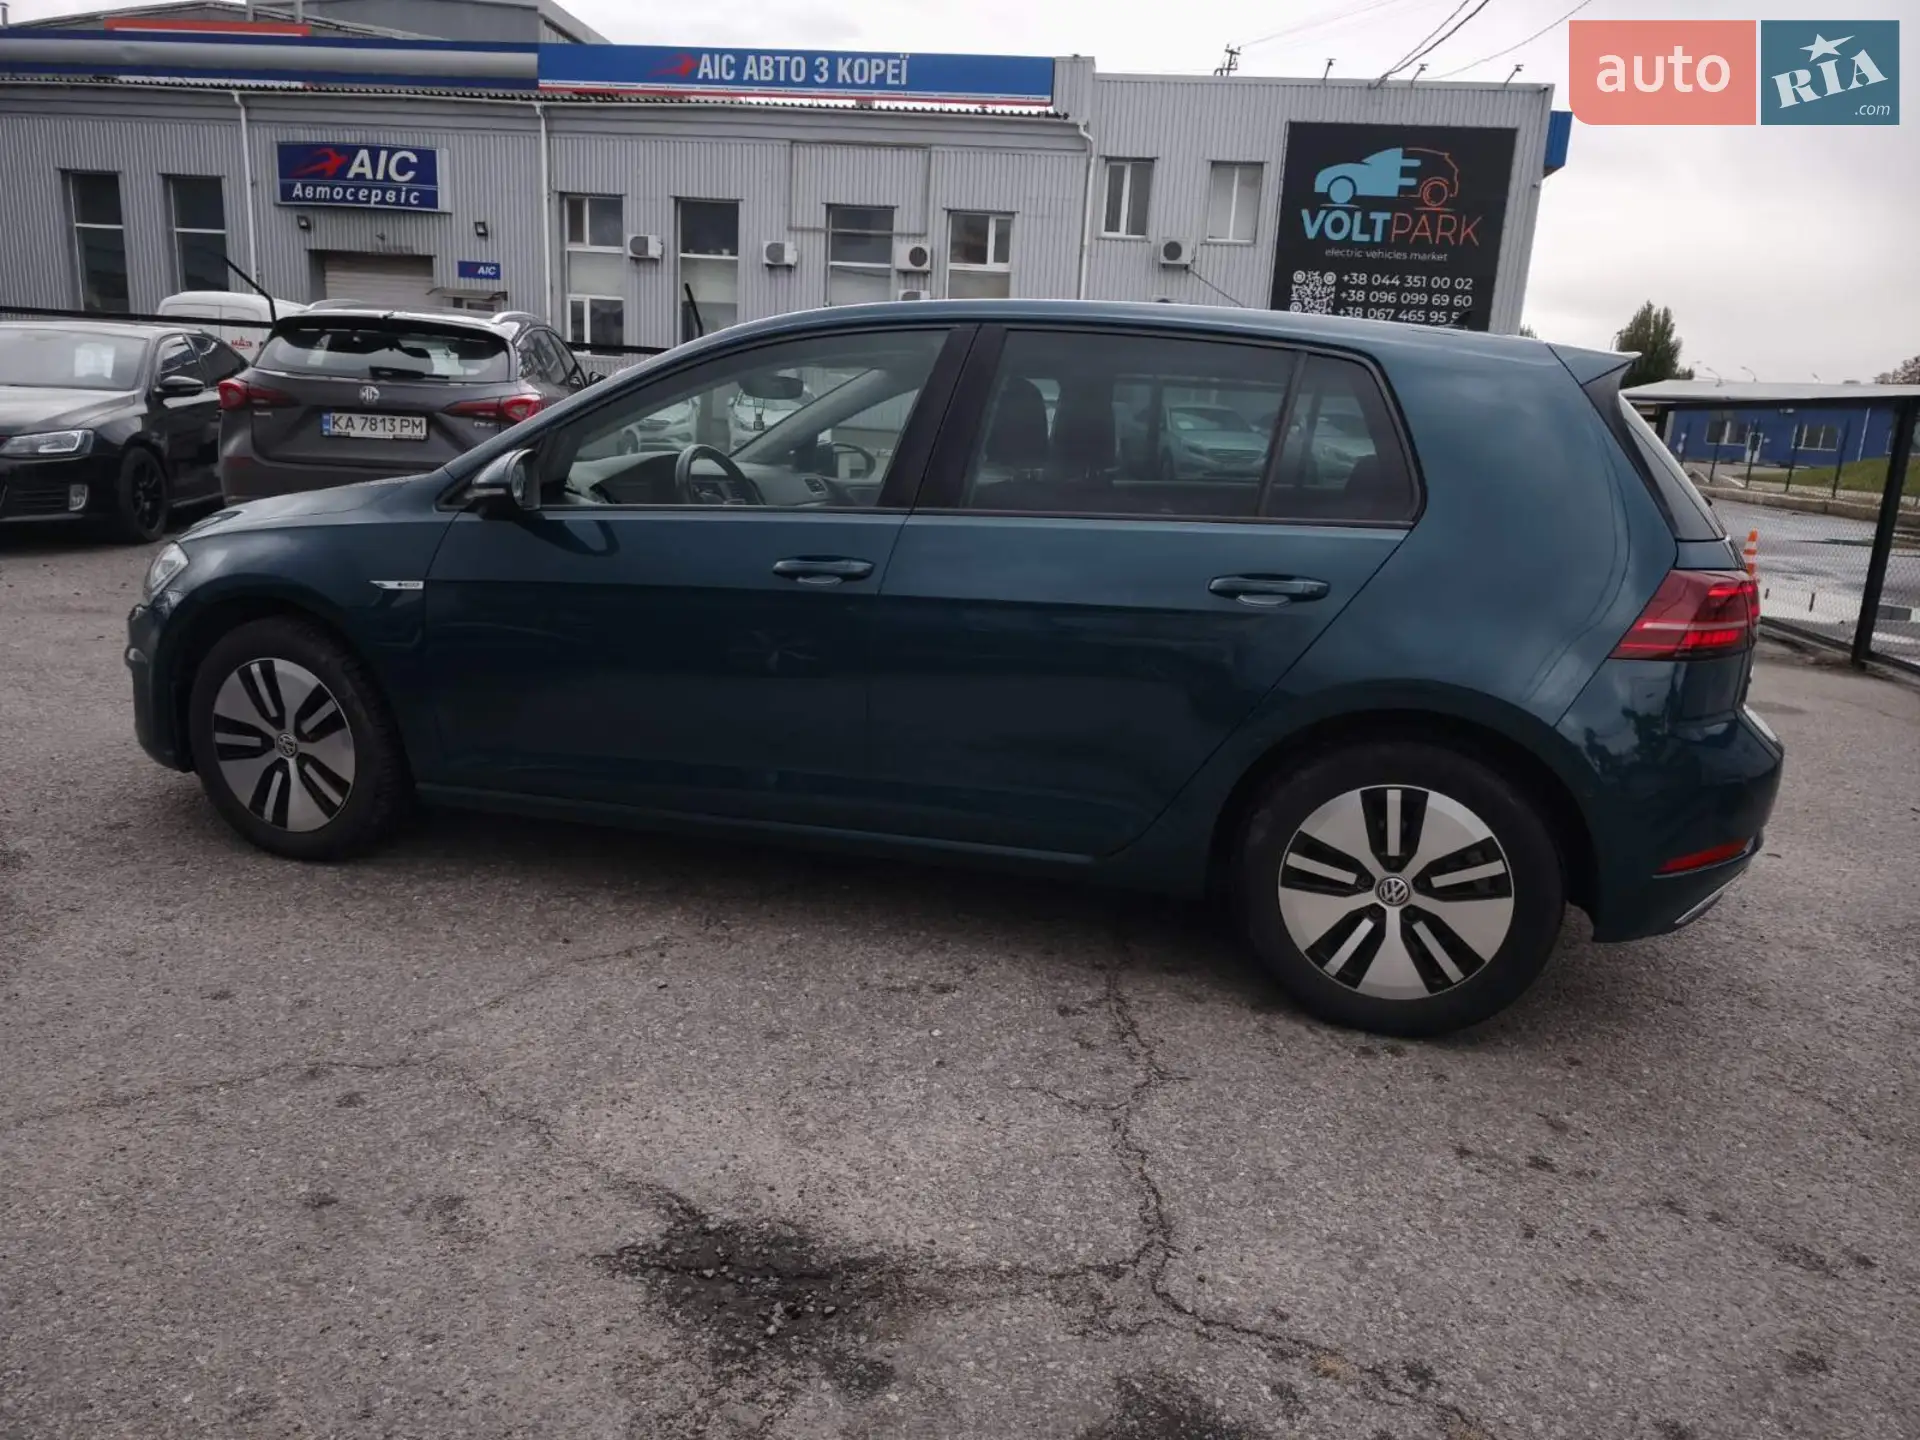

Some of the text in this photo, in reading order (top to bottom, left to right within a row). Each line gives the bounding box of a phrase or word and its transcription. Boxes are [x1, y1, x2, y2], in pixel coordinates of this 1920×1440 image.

[743, 54, 806, 82] АВТО
[814, 57, 829, 84] З
[837, 53, 910, 85] КОРЕЇ
[292, 182, 421, 205] Автосервіс
[1301, 208, 1483, 247] VOLTPARK
[1325, 248, 1448, 262] electric vehicles market
[1342, 272, 1473, 290] +38 044 351 00 02
[1340, 290, 1473, 307] +38 096 099 69 60
[1338, 306, 1363, 318] +38
[1367, 308, 1395, 320] 067
[1398, 309, 1425, 322] 465
[1429, 310, 1447, 323] 95
[331, 415, 424, 434] KA 7813 PM
